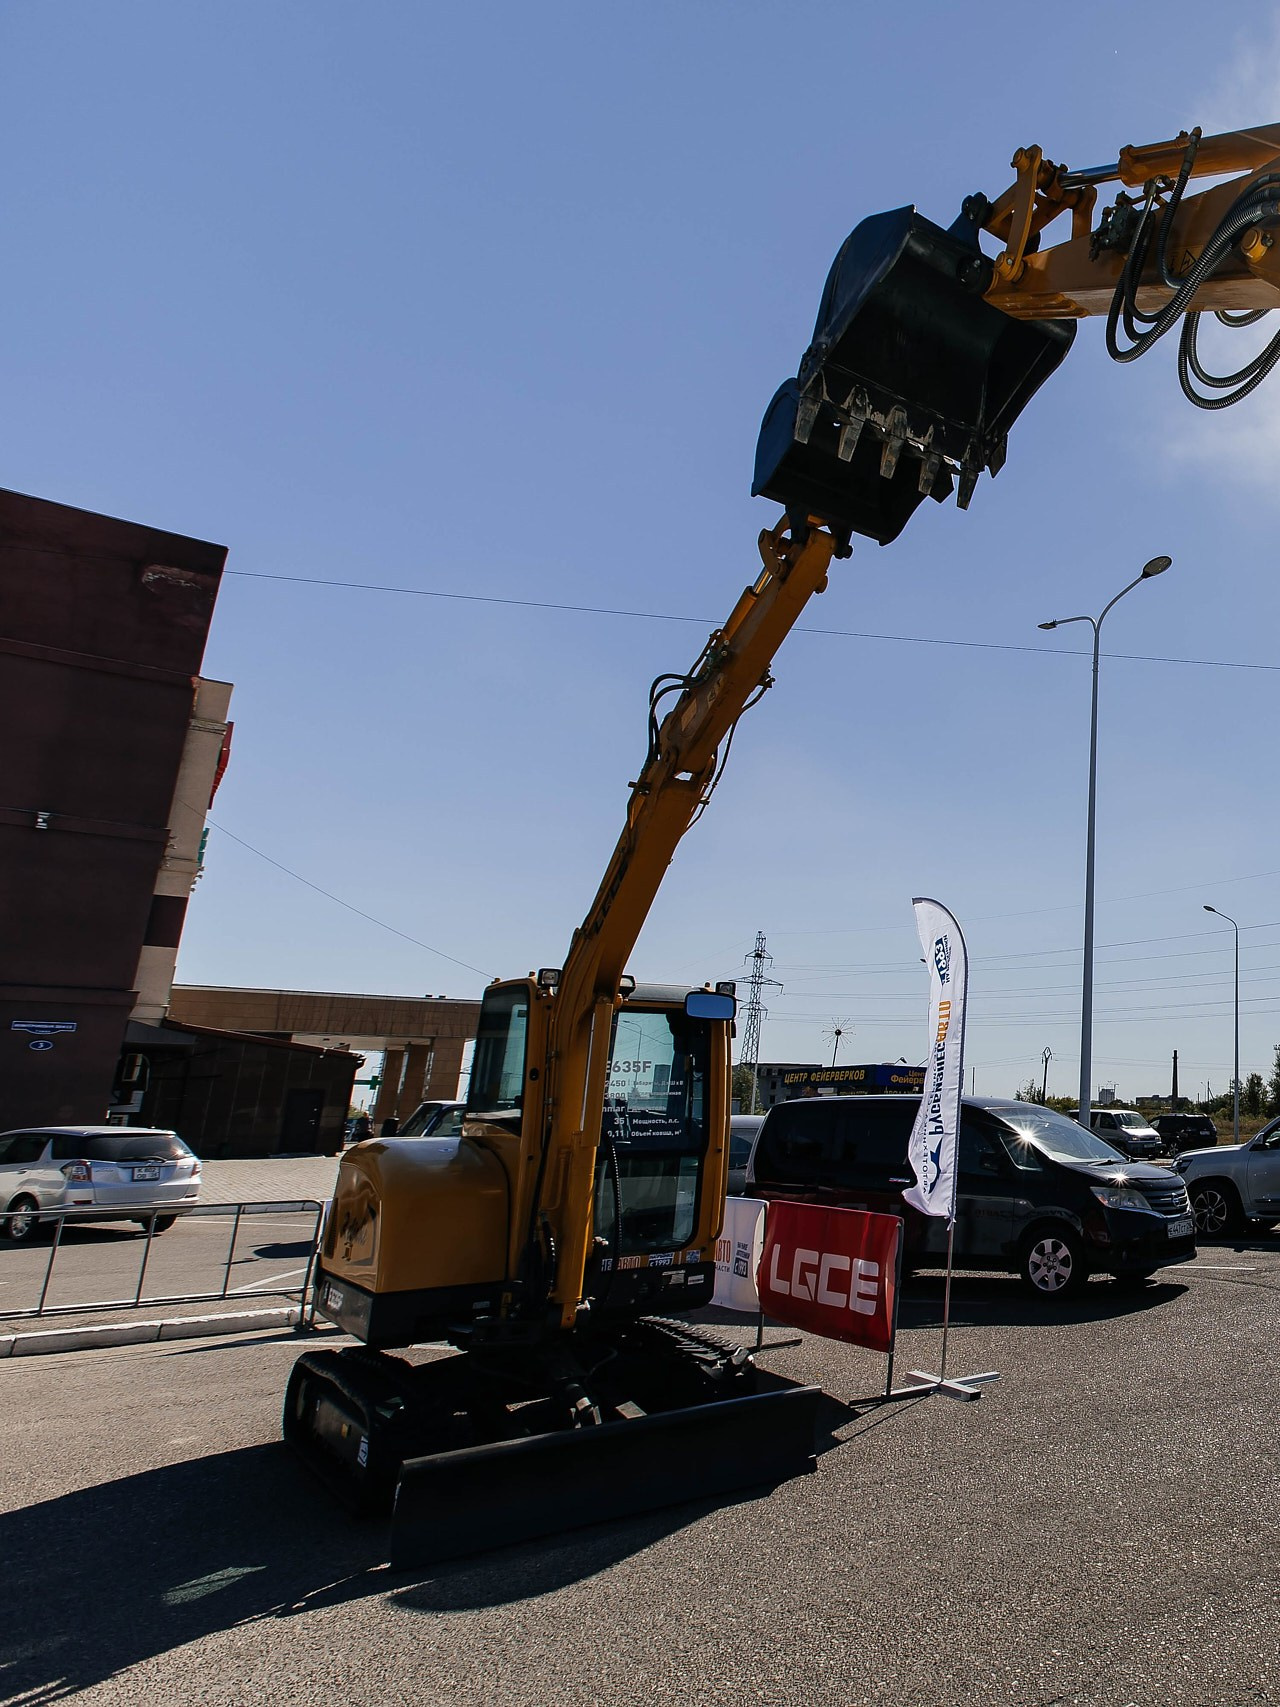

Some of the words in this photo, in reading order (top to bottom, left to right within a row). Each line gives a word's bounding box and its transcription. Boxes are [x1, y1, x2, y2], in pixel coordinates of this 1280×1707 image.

[784, 1072, 808, 1085] ЦЕНТР
[810, 1069, 866, 1082] ФЕЙЕРВЕРКОВ
[769, 1243, 880, 1316] LGCE
